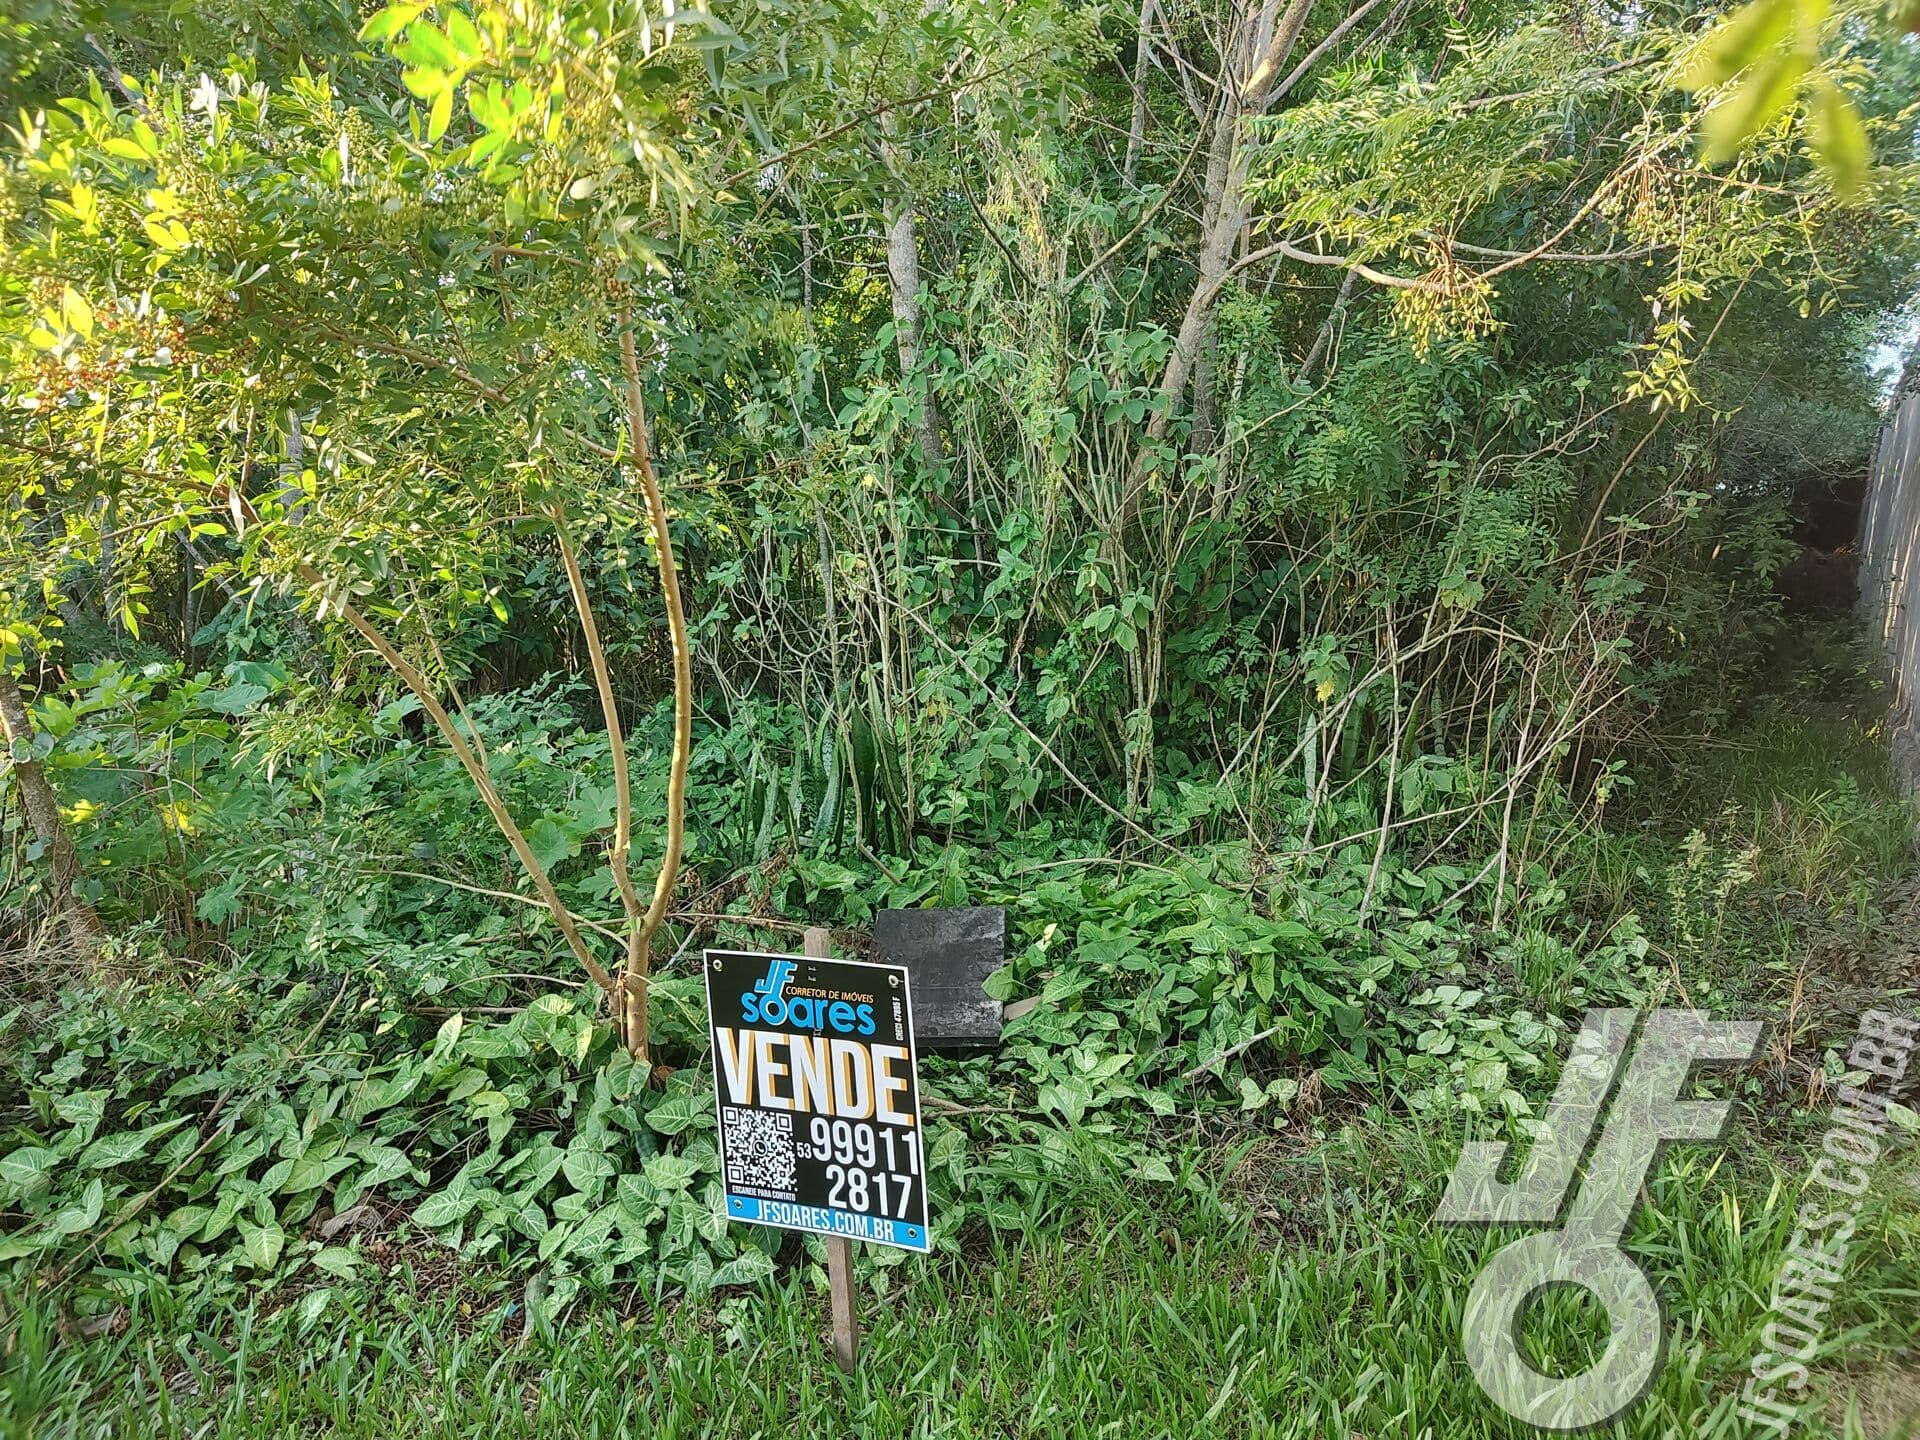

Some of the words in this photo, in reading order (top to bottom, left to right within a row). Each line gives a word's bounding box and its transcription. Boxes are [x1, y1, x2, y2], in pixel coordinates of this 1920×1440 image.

[754, 959, 799, 994] JF
[785, 986, 827, 998] CORRETOR
[828, 990, 840, 1000] DE
[841, 991, 875, 1003] IMÓVEIS
[741, 992, 876, 1035] soares
[715, 1026, 914, 1127] VENDE
[796, 1142, 812, 1159] 53
[810, 1117, 919, 1175] 99911
[757, 1189, 772, 1198] PARA
[772, 1190, 796, 1201] CONTATO
[825, 1164, 912, 1219] 2817
[756, 1199, 895, 1242] JFSOARES.COM.BR
